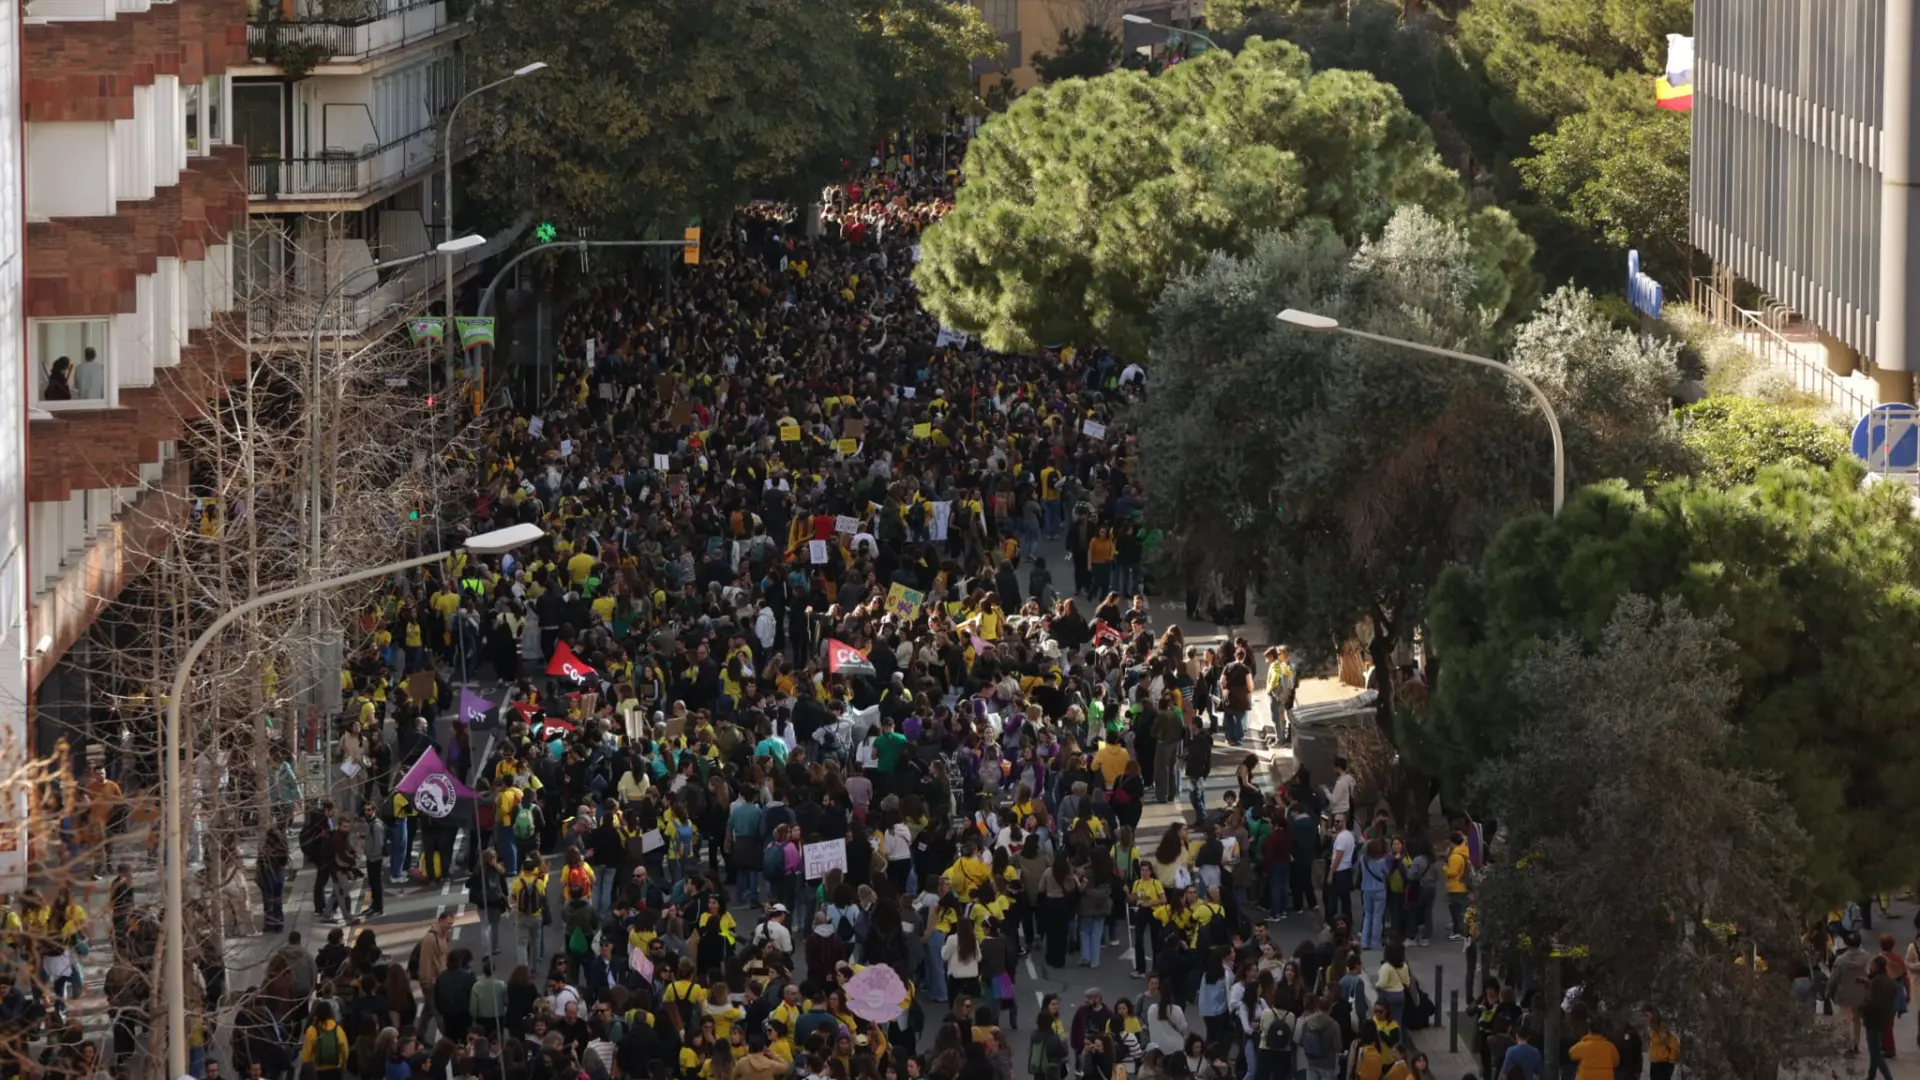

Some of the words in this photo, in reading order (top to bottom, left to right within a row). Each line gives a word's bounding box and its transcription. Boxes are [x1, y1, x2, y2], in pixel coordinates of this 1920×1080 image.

[837, 648, 862, 664] CG
[562, 662, 586, 686] CGT
[420, 793, 438, 811] CGT
